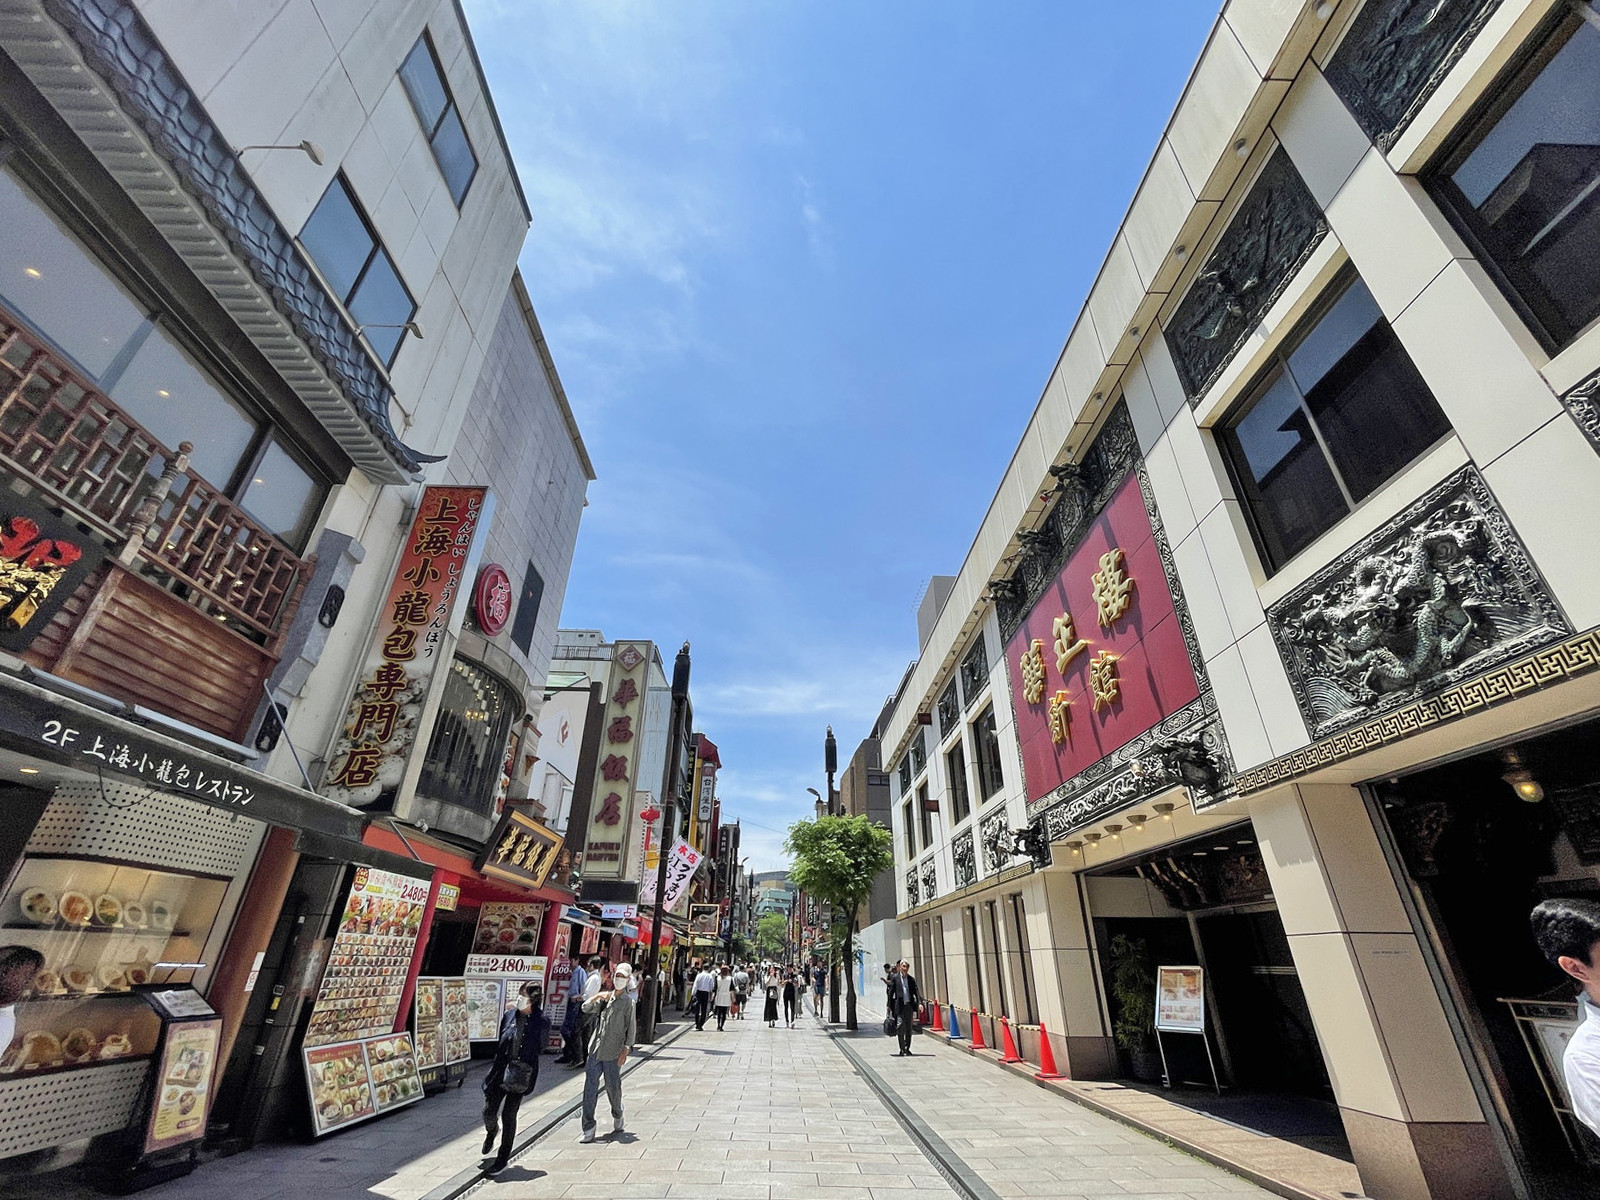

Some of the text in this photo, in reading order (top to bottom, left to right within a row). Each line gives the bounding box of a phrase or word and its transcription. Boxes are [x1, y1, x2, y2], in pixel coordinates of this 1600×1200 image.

[331, 496, 461, 789] 上海小龍包専門店
[623, 652, 636, 664] 福
[1048, 649, 1118, 744] 新館
[41, 720, 80, 746] 2F
[595, 677, 639, 827] 華福飯店
[496, 825, 556, 877] 華福飯店
[677, 844, 698, 865] 本店
[624, 905, 634, 918] 占
[489, 958, 530, 973] 2480円
